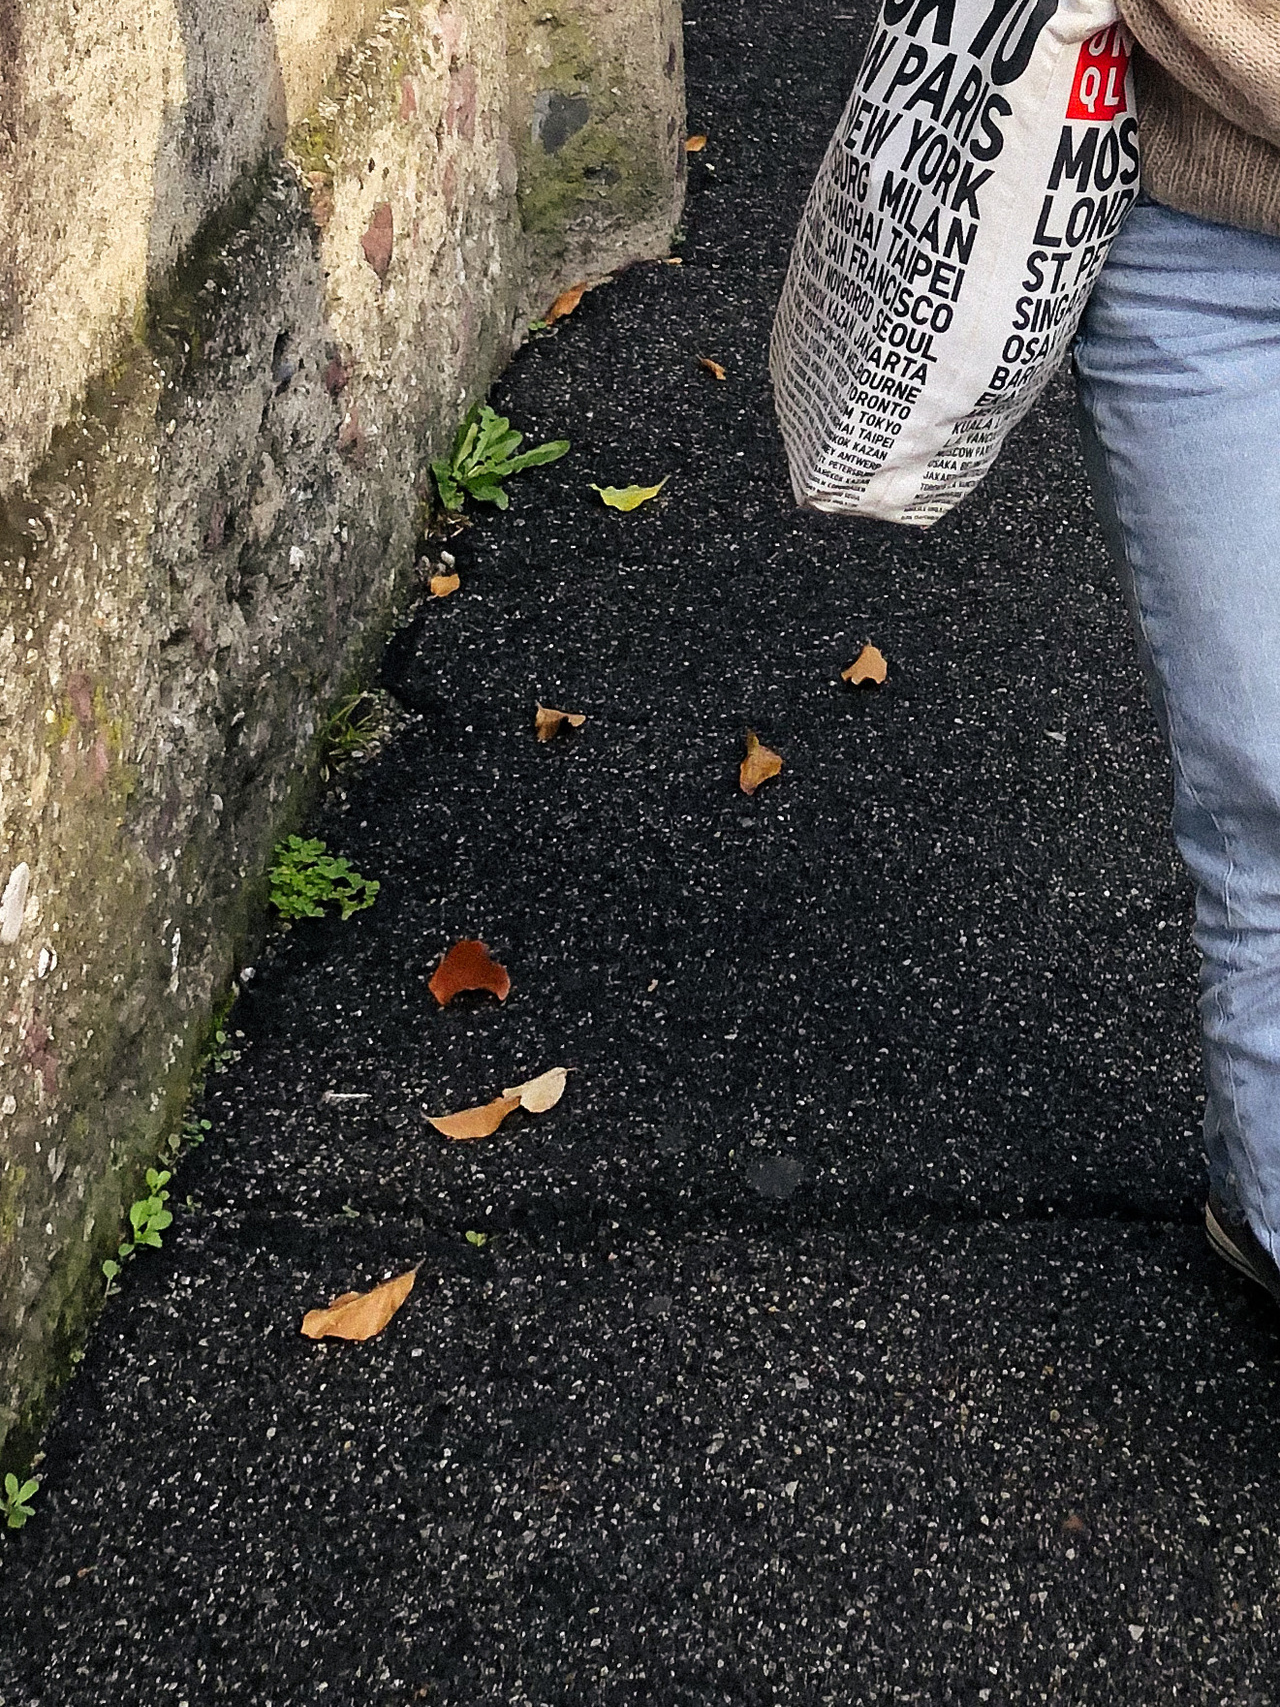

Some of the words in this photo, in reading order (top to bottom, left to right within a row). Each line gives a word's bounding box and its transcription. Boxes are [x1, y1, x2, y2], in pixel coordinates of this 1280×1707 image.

[881, 42, 1013, 161] PARIS
[842, 94, 904, 160] NEW
[899, 118, 996, 221] YORK
[877, 170, 979, 265] MILAN
[1032, 188, 1136, 248] LOND
[825, 227, 848, 267] SAN
[848, 243, 954, 333] FRANCISCO
[886, 225, 967, 302] TAIPEI
[1021, 250, 1073, 294] ST.
[1072, 237, 1114, 287] PE
[824, 263, 875, 322] NOVGOROD
[871, 307, 938, 363] SEOUL
[826, 297, 858, 339] KAZAN
[852, 327, 928, 386] JAKARTA
[846, 349, 922, 404] MELBOURNE
[848, 382, 911, 421] TORONTO
[852, 441, 889, 462] KAZAN
[858, 427, 896, 449] TAIPEI
[859, 410, 902, 436] TOKYO
[837, 451, 882, 471] ANTWERP
